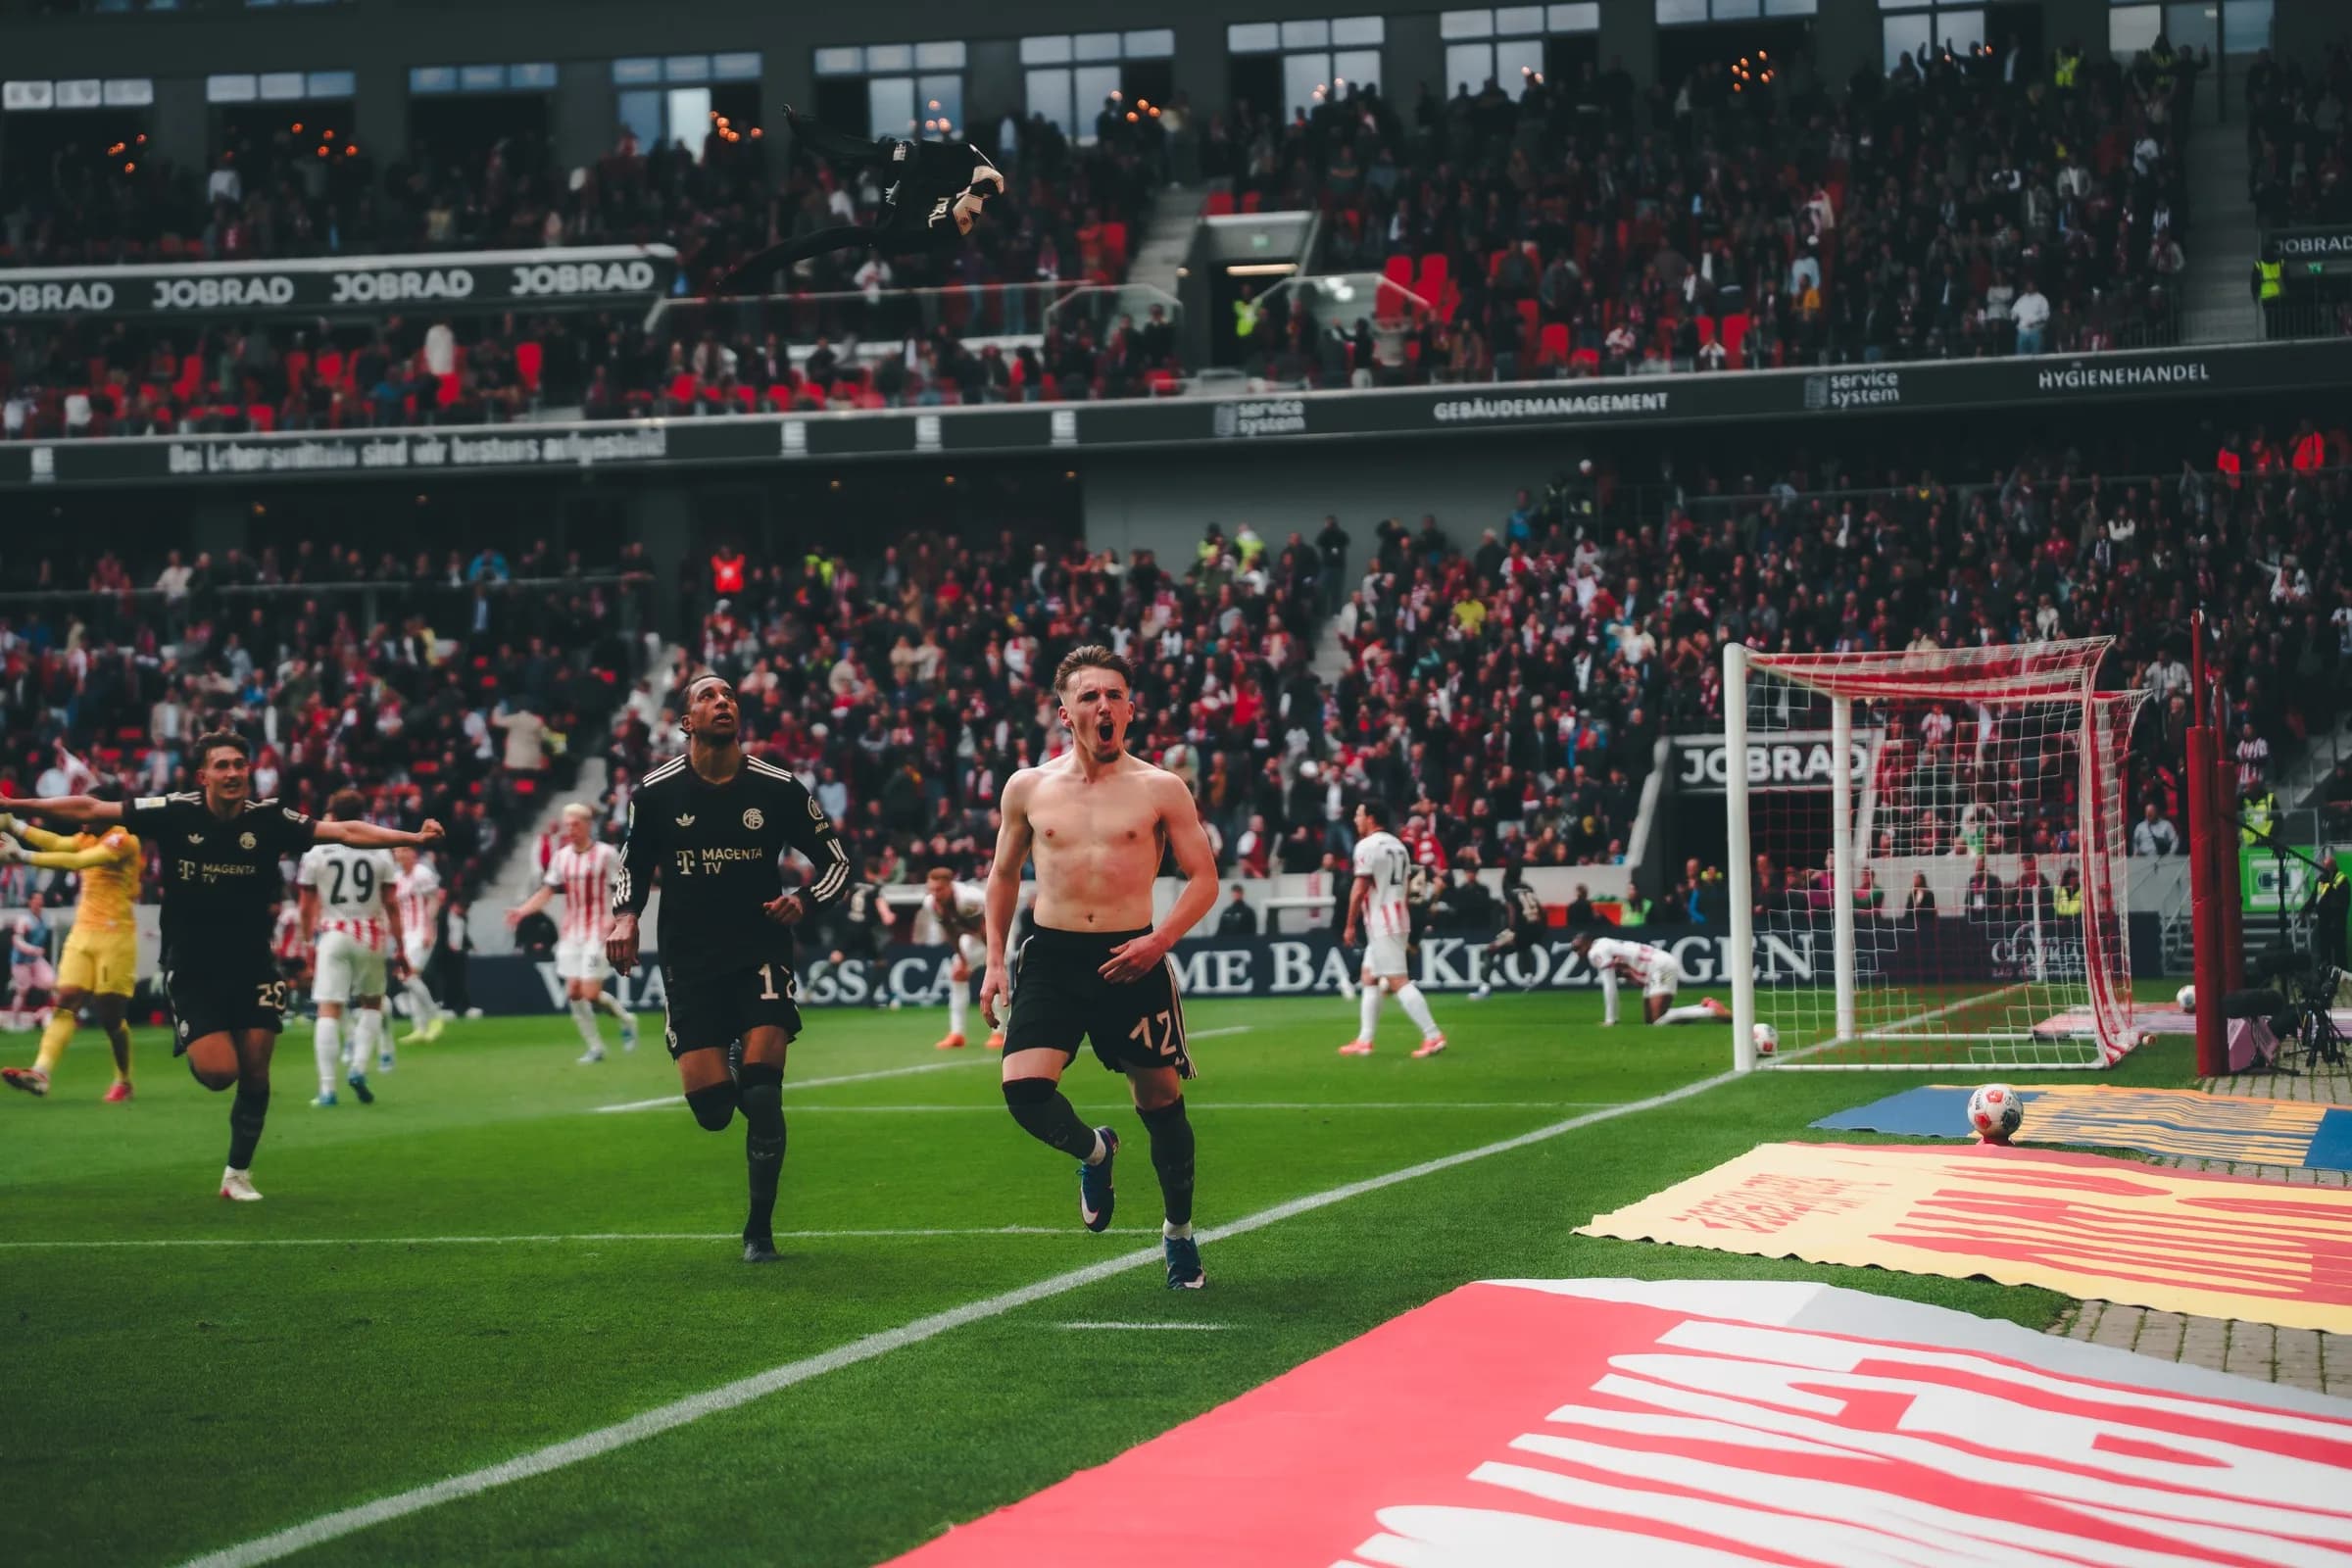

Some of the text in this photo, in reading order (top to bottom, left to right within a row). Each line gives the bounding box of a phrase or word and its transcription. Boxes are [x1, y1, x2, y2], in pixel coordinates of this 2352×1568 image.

[2275, 234, 2352, 254] JOBRAD
[331, 270, 473, 303] JOBRAD
[511, 262, 654, 295] JOBRAD
[0, 281, 114, 313] OBRAD
[152, 276, 294, 309] JOBRAD
[1830, 368, 1898, 389] service
[2038, 363, 2210, 389] HYGIENEHANDEL
[1238, 399, 1304, 418] service
[1433, 392, 1669, 421] GEBÄUDEMANAGEMENT
[1830, 387, 1900, 409] system
[1238, 416, 1306, 439] system
[702, 847, 763, 861] MAGENTA
[202, 872, 218, 883] TV
[203, 863, 257, 875] MAGENTA
[703, 861, 722, 875] TV
[327, 858, 375, 905] 29
[535, 961, 669, 1007] VTA
[1170, 949, 1253, 994] ME
[1268, 941, 1363, 993] BA
[1413, 933, 1814, 989] KROZGEN
